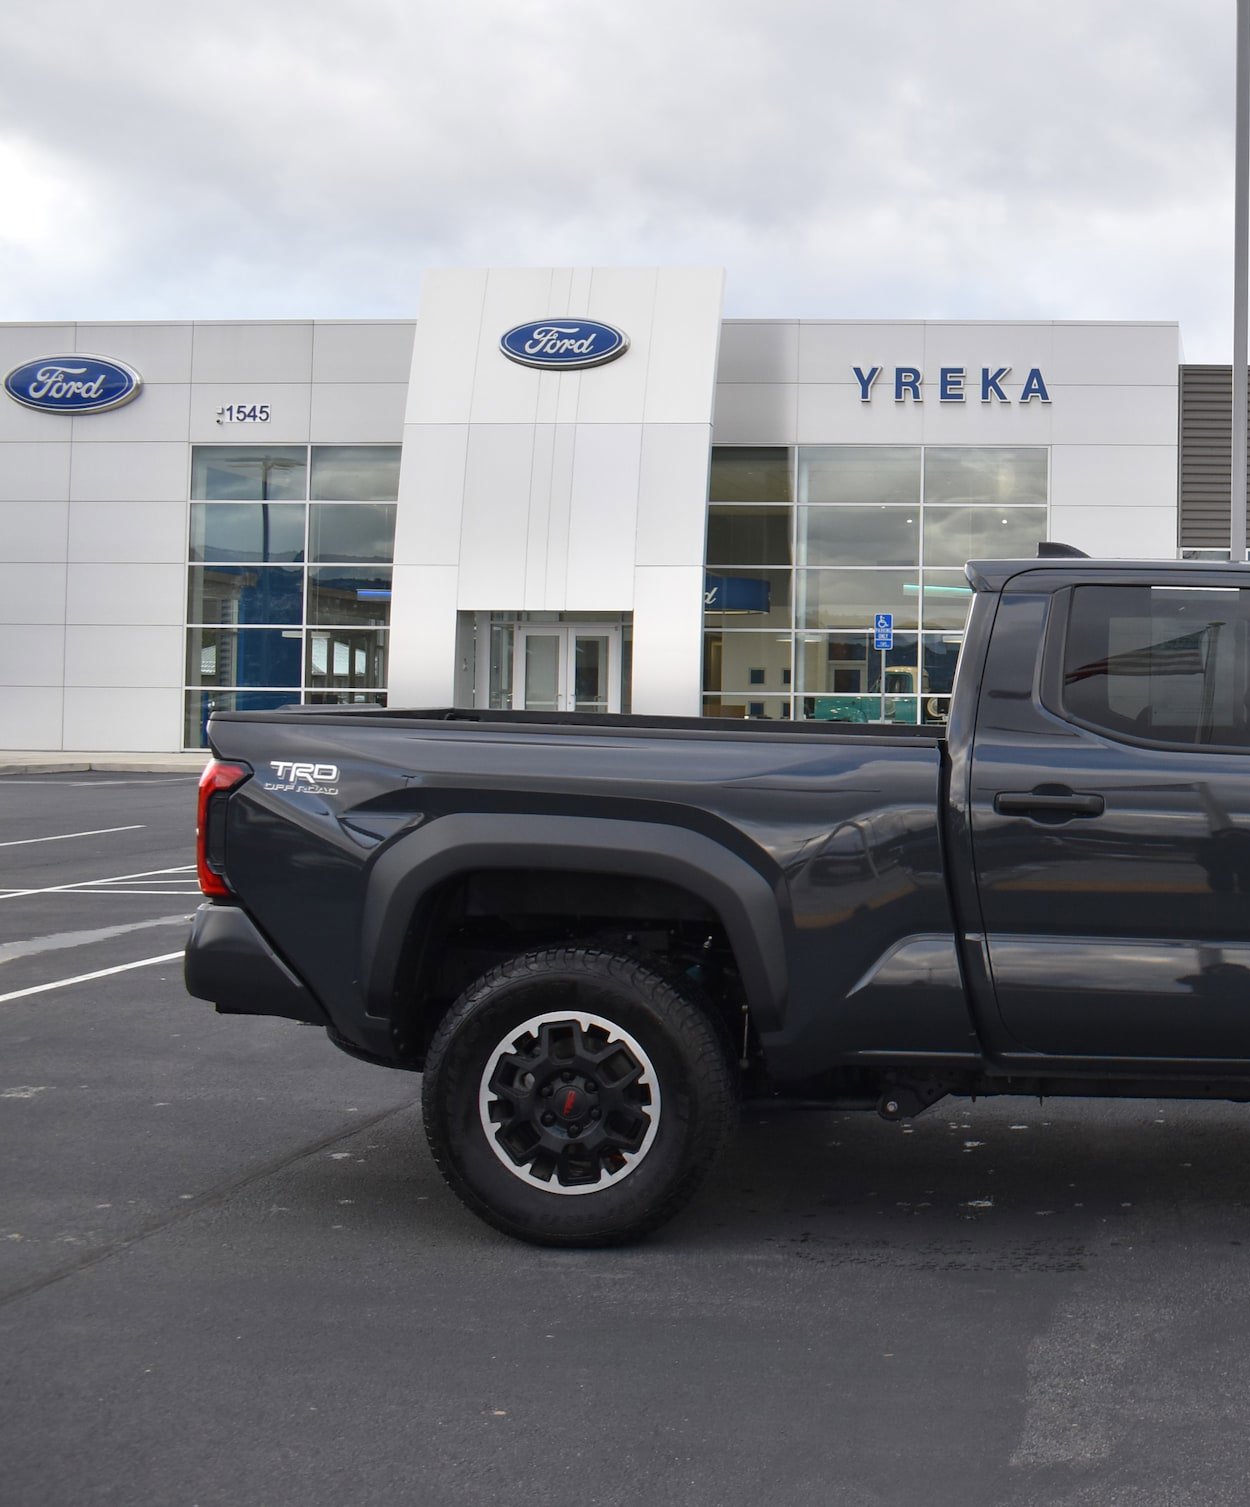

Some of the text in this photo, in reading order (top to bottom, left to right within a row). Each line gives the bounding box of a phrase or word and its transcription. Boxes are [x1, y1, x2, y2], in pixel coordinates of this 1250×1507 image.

[524, 326, 597, 354] Ford
[29, 366, 106, 399] Ford
[852, 366, 1052, 403] YREKA
[226, 405, 270, 422] 1545
[270, 761, 339, 784] TRD
[264, 782, 295, 791] OFF
